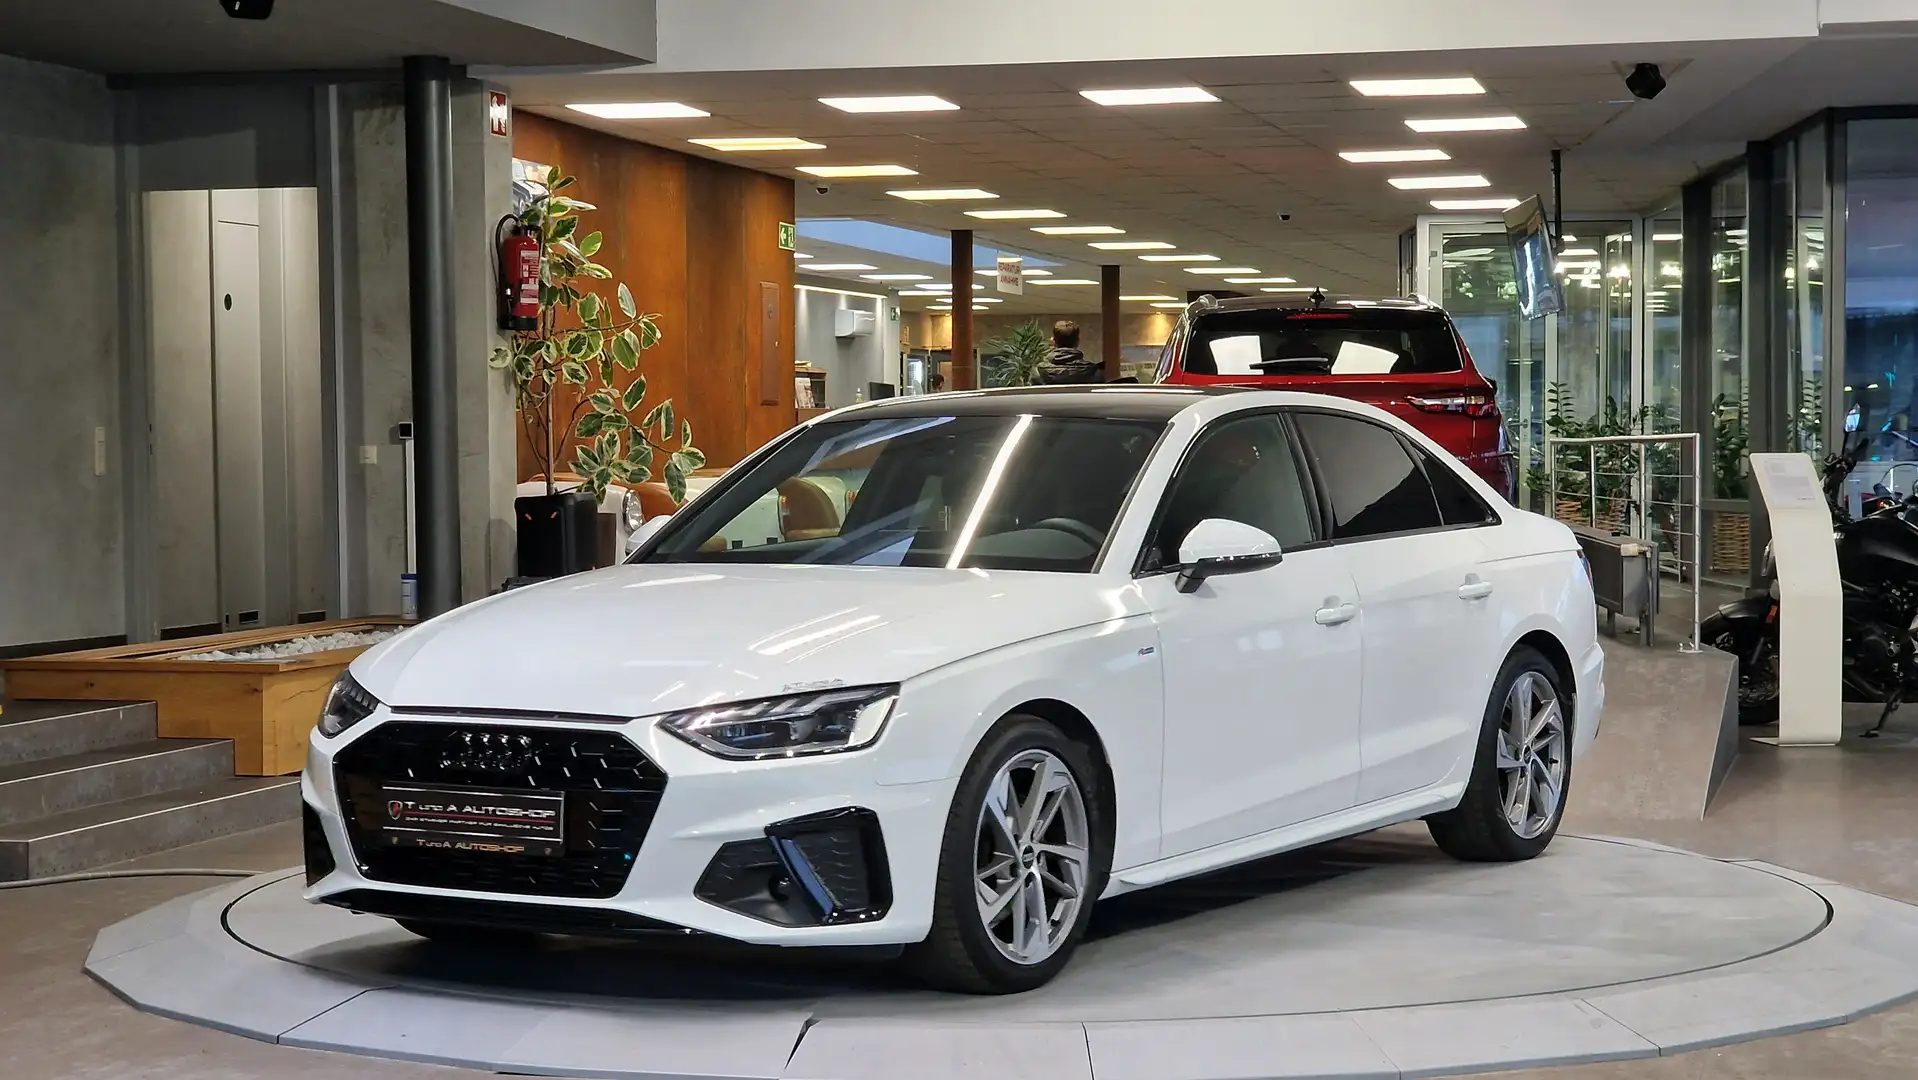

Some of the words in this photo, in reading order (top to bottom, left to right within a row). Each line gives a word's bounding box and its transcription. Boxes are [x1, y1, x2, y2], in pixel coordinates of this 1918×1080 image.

[403, 801, 416, 809] T
[446, 804, 458, 812] A
[462, 804, 556, 818] AUTOSHOP
[416, 838, 426, 846] T
[455, 842, 525, 853] AUTOSHOP
